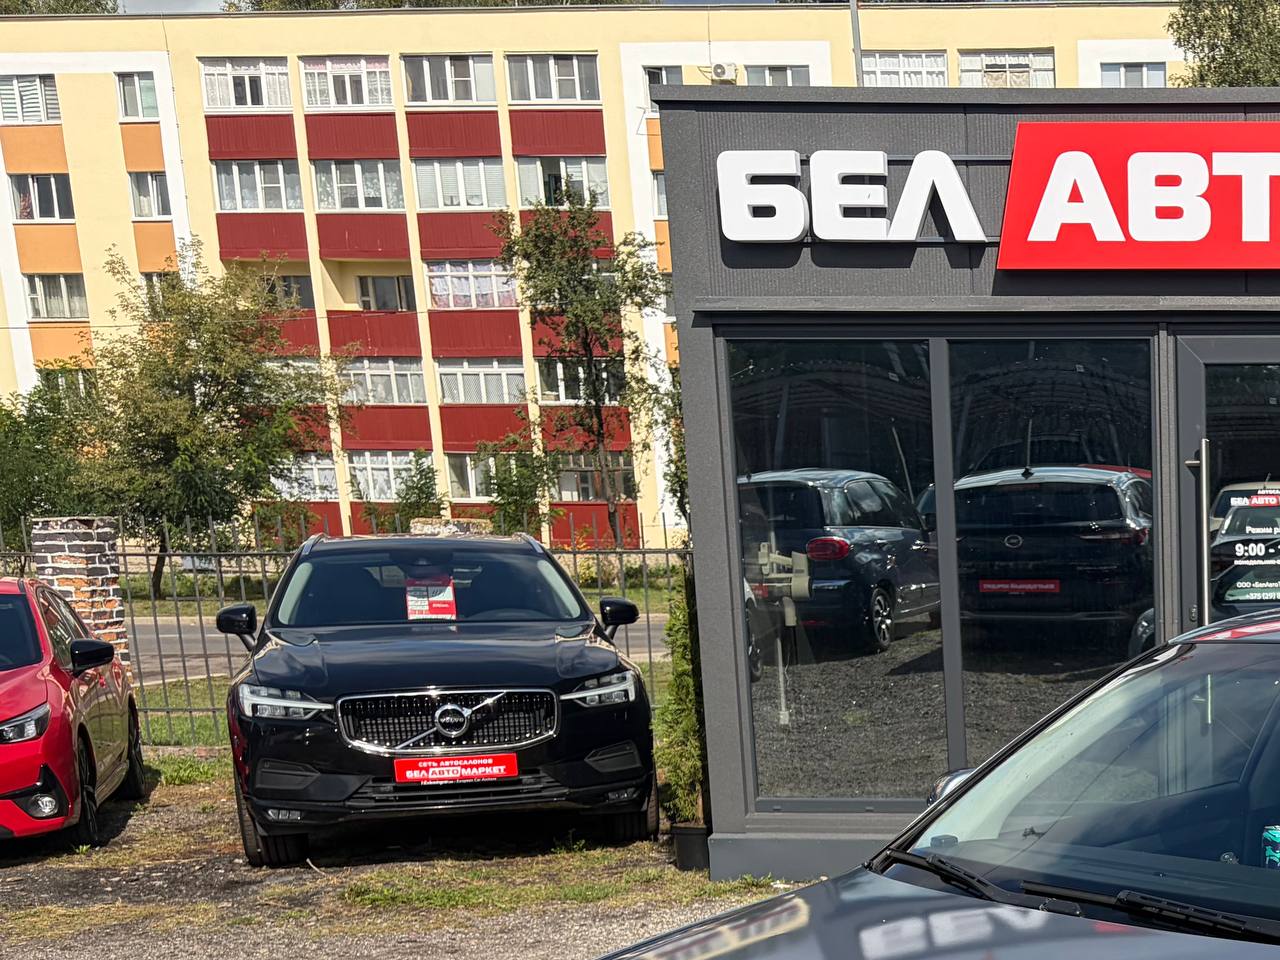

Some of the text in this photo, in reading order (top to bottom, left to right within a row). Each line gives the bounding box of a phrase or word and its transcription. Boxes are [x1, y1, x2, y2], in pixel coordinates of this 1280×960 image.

[717, 150, 988, 243] БЕЛ
[1251, 497, 1277, 505] АВТО
[1235, 543, 1265, 556] 9:00
[440, 758, 493, 766] АВТОСАЛОНОВ
[406, 766, 506, 778] БЕЛ АВТО МАРКЕТ
